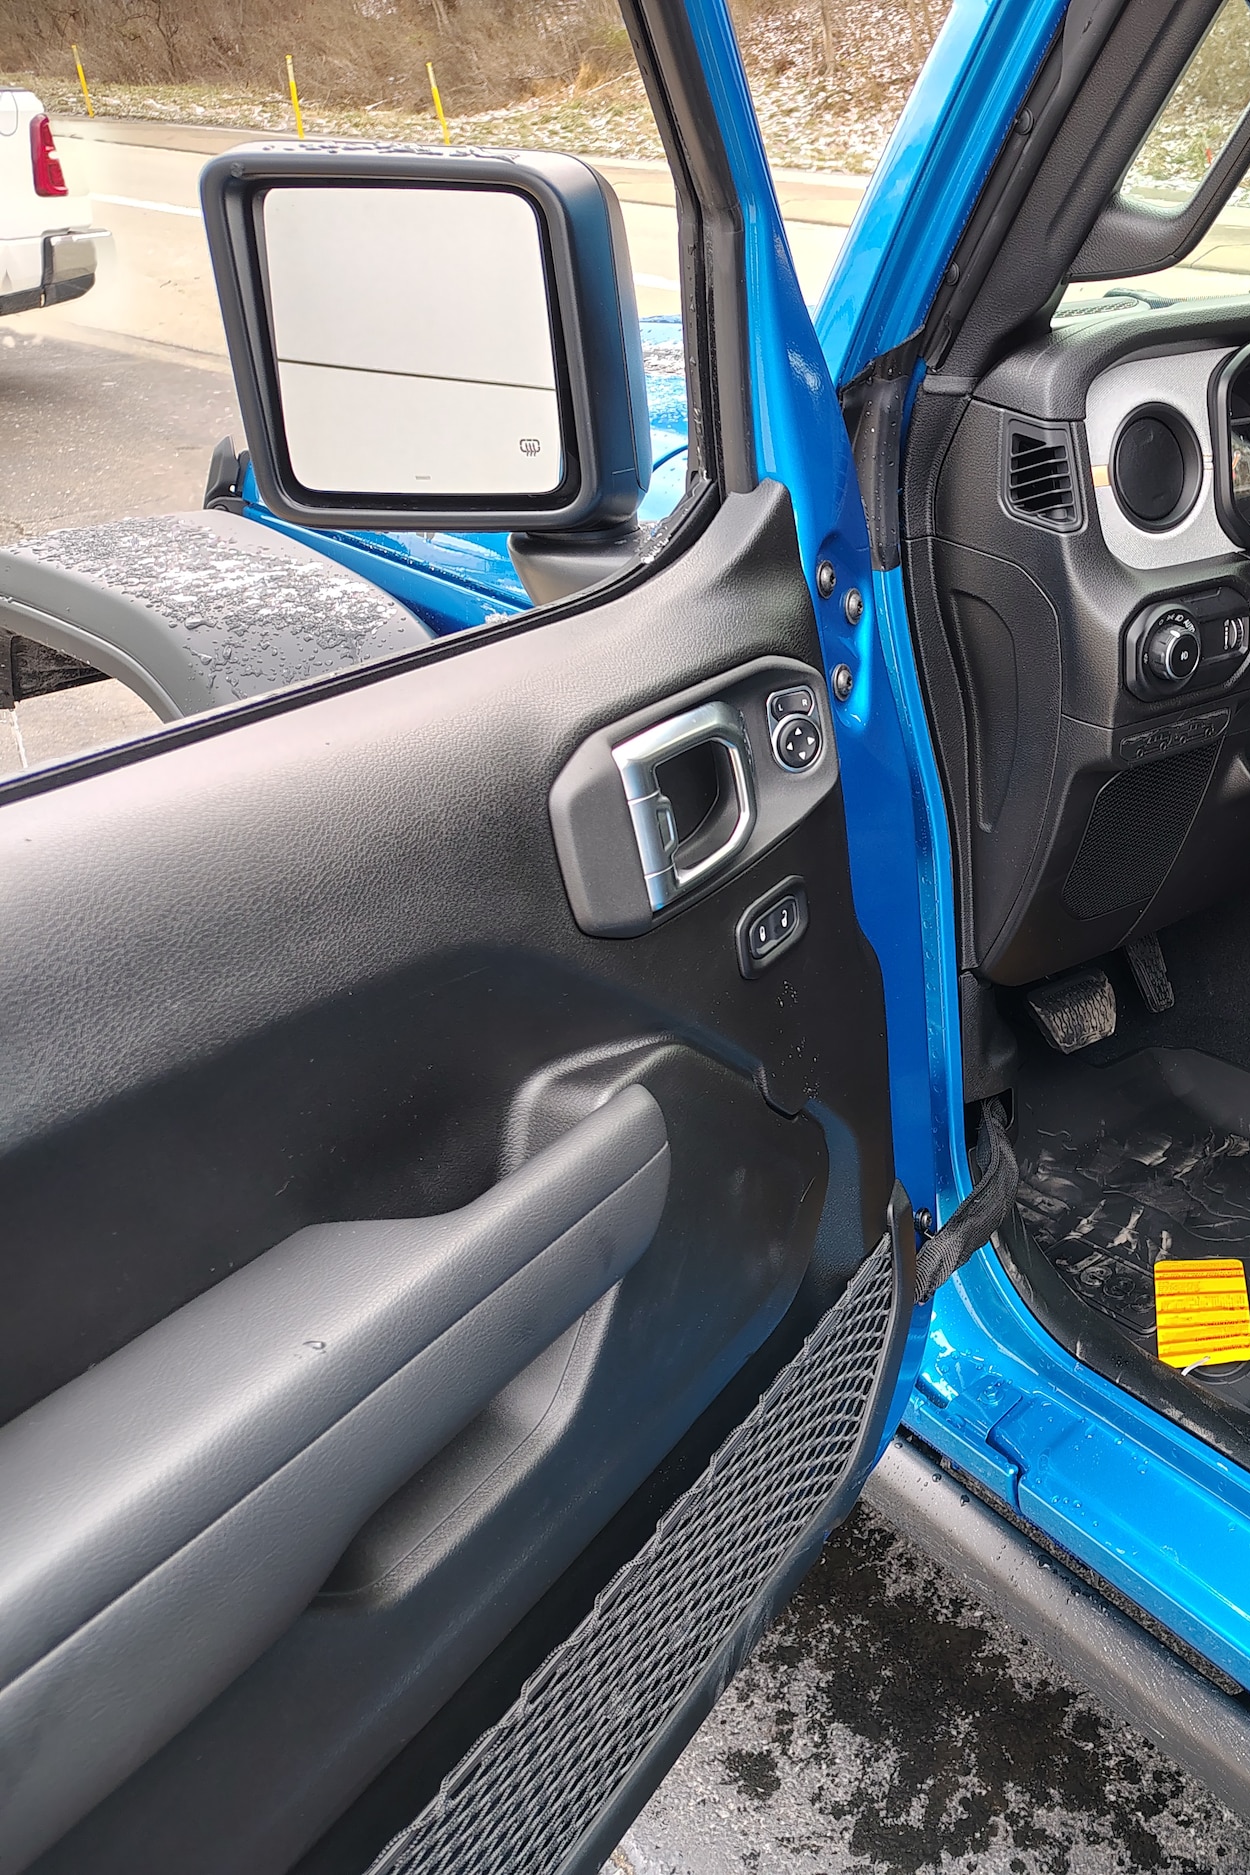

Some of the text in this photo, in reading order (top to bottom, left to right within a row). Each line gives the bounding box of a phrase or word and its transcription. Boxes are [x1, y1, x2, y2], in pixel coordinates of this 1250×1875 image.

[1183, 618, 1196, 633] AUTO
[778, 698, 808, 711] L R
